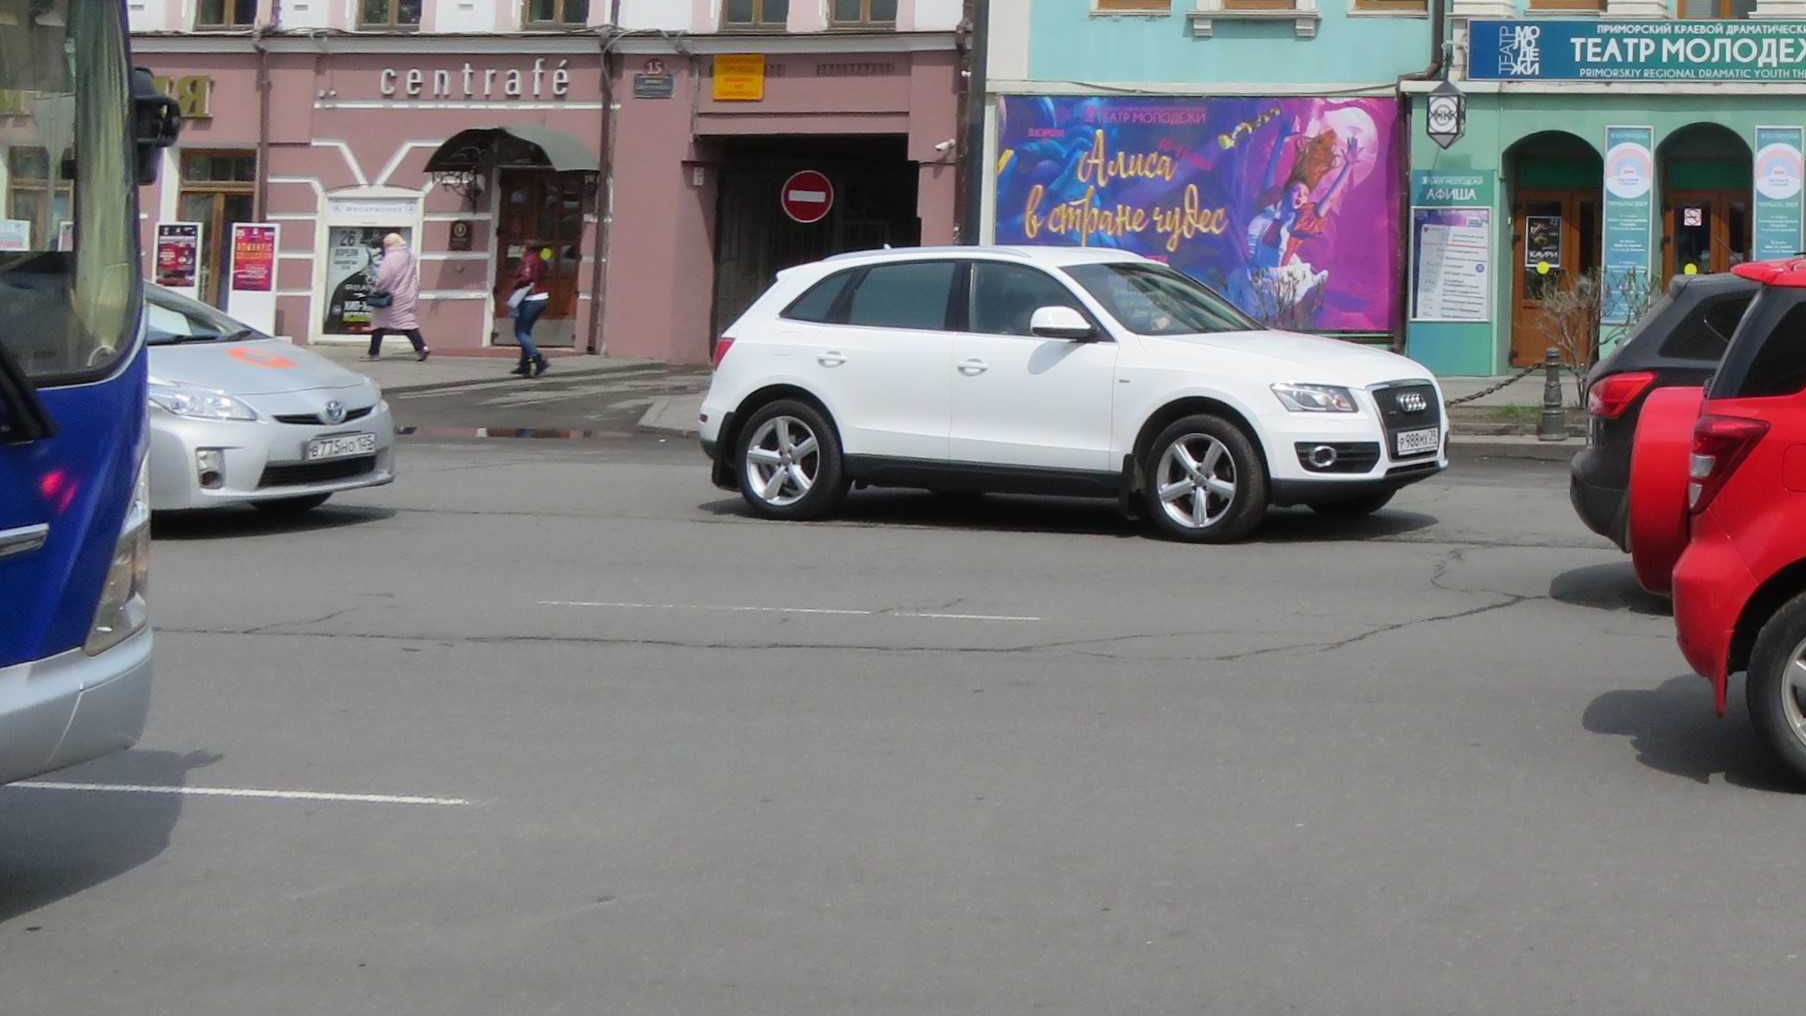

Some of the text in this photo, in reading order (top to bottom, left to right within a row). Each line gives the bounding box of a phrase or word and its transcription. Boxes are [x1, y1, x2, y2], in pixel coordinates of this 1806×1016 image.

[1597, 23, 1672, 35] ПРИМОРСКИЙ
[1674, 23, 1723, 35] КРАЕВОЙ
[1570, 37, 1656, 63] ТЕАТР
[380, 58, 569, 96] centrafé
[647, 62, 663, 74] 15
[1579, 67, 1642, 79] PRIMORSKIY
[1644, 68, 1697, 79] REGIONAL
[1698, 68, 1751, 79] DRAMATIC
[1753, 69, 1790, 80] YOUTH
[1077, 128, 1178, 187] Алиса
[1426, 188, 1478, 201] АФИША
[1024, 184, 1230, 252] в стране чудес
